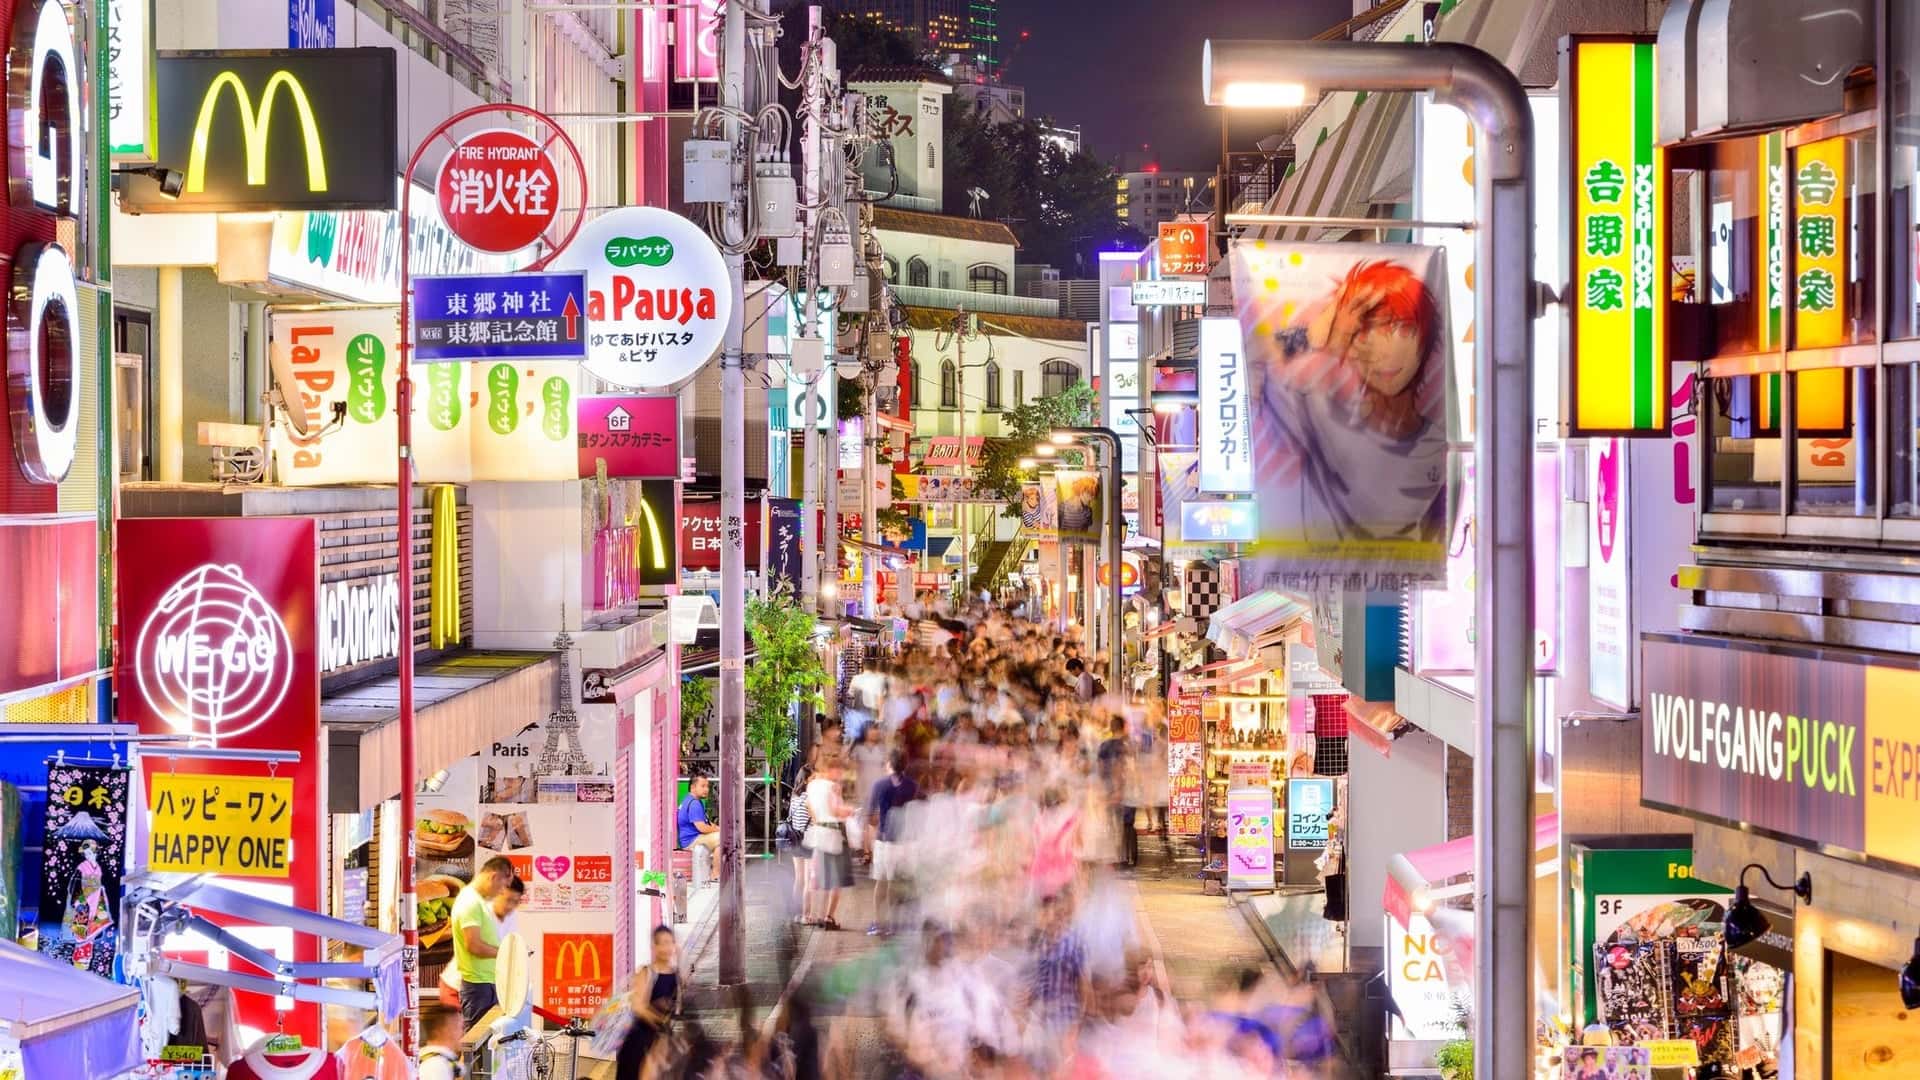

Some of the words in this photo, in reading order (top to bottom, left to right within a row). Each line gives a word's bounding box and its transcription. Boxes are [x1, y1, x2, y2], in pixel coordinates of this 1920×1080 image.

[459, 146, 484, 161] FIRE
[487, 147, 540, 161] HYDRANT
[450, 168, 551, 215] 消火栓
[1587, 160, 1623, 310] 吉野家
[1635, 164, 1652, 309] YOSHINOYA
[607, 246, 670, 258] ラパウザ
[446, 291, 552, 315] 東郷神社
[590, 292, 606, 321] a
[613, 276, 716, 325] Pausa
[447, 320, 558, 344] 東郷記念館
[619, 350, 658, 363] &ピザ
[611, 415, 627, 427] 6F
[1219, 353, 1237, 471] コインロッカー
[492, 742, 529, 757] Paris
[63, 786, 112, 809] 日本
[156, 786, 288, 823] ハッピーワン
[1293, 814, 1321, 823] コイン
[1293, 824, 1327, 834] ロッカー
[153, 833, 230, 867] HAPPY
[238, 838, 284, 868] ONE
[514, 865, 531, 877] ell
[1600, 901, 1622, 915] 3F
[167, 1051, 196, 1060] ¥540
